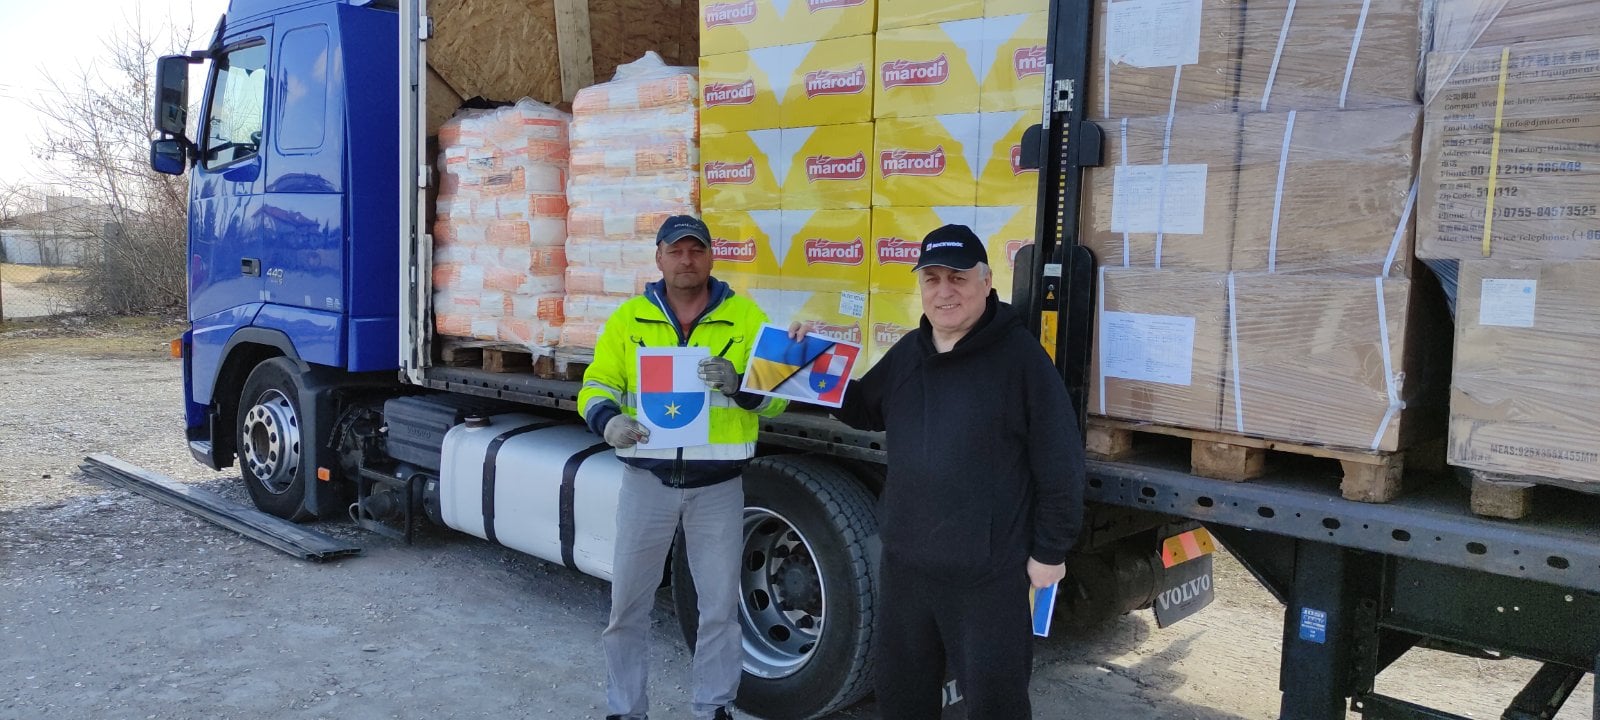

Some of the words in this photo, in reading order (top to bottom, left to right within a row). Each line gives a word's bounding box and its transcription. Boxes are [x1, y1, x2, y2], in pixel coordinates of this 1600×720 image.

[706, 4, 754, 23] marodi
[808, 71, 863, 91] marodi
[885, 64, 944, 82] marodi
[706, 83, 753, 102] marodi
[1506, 116, 1580, 128] info@djmiot.com
[706, 161, 753, 179] marodi
[809, 156, 863, 175] marodi
[884, 153, 942, 172] marodi
[808, 244, 862, 259] marodi
[880, 245, 921, 258] maro
[816, 327, 857, 342] arodi
[1157, 573, 1211, 611] VOLVO
